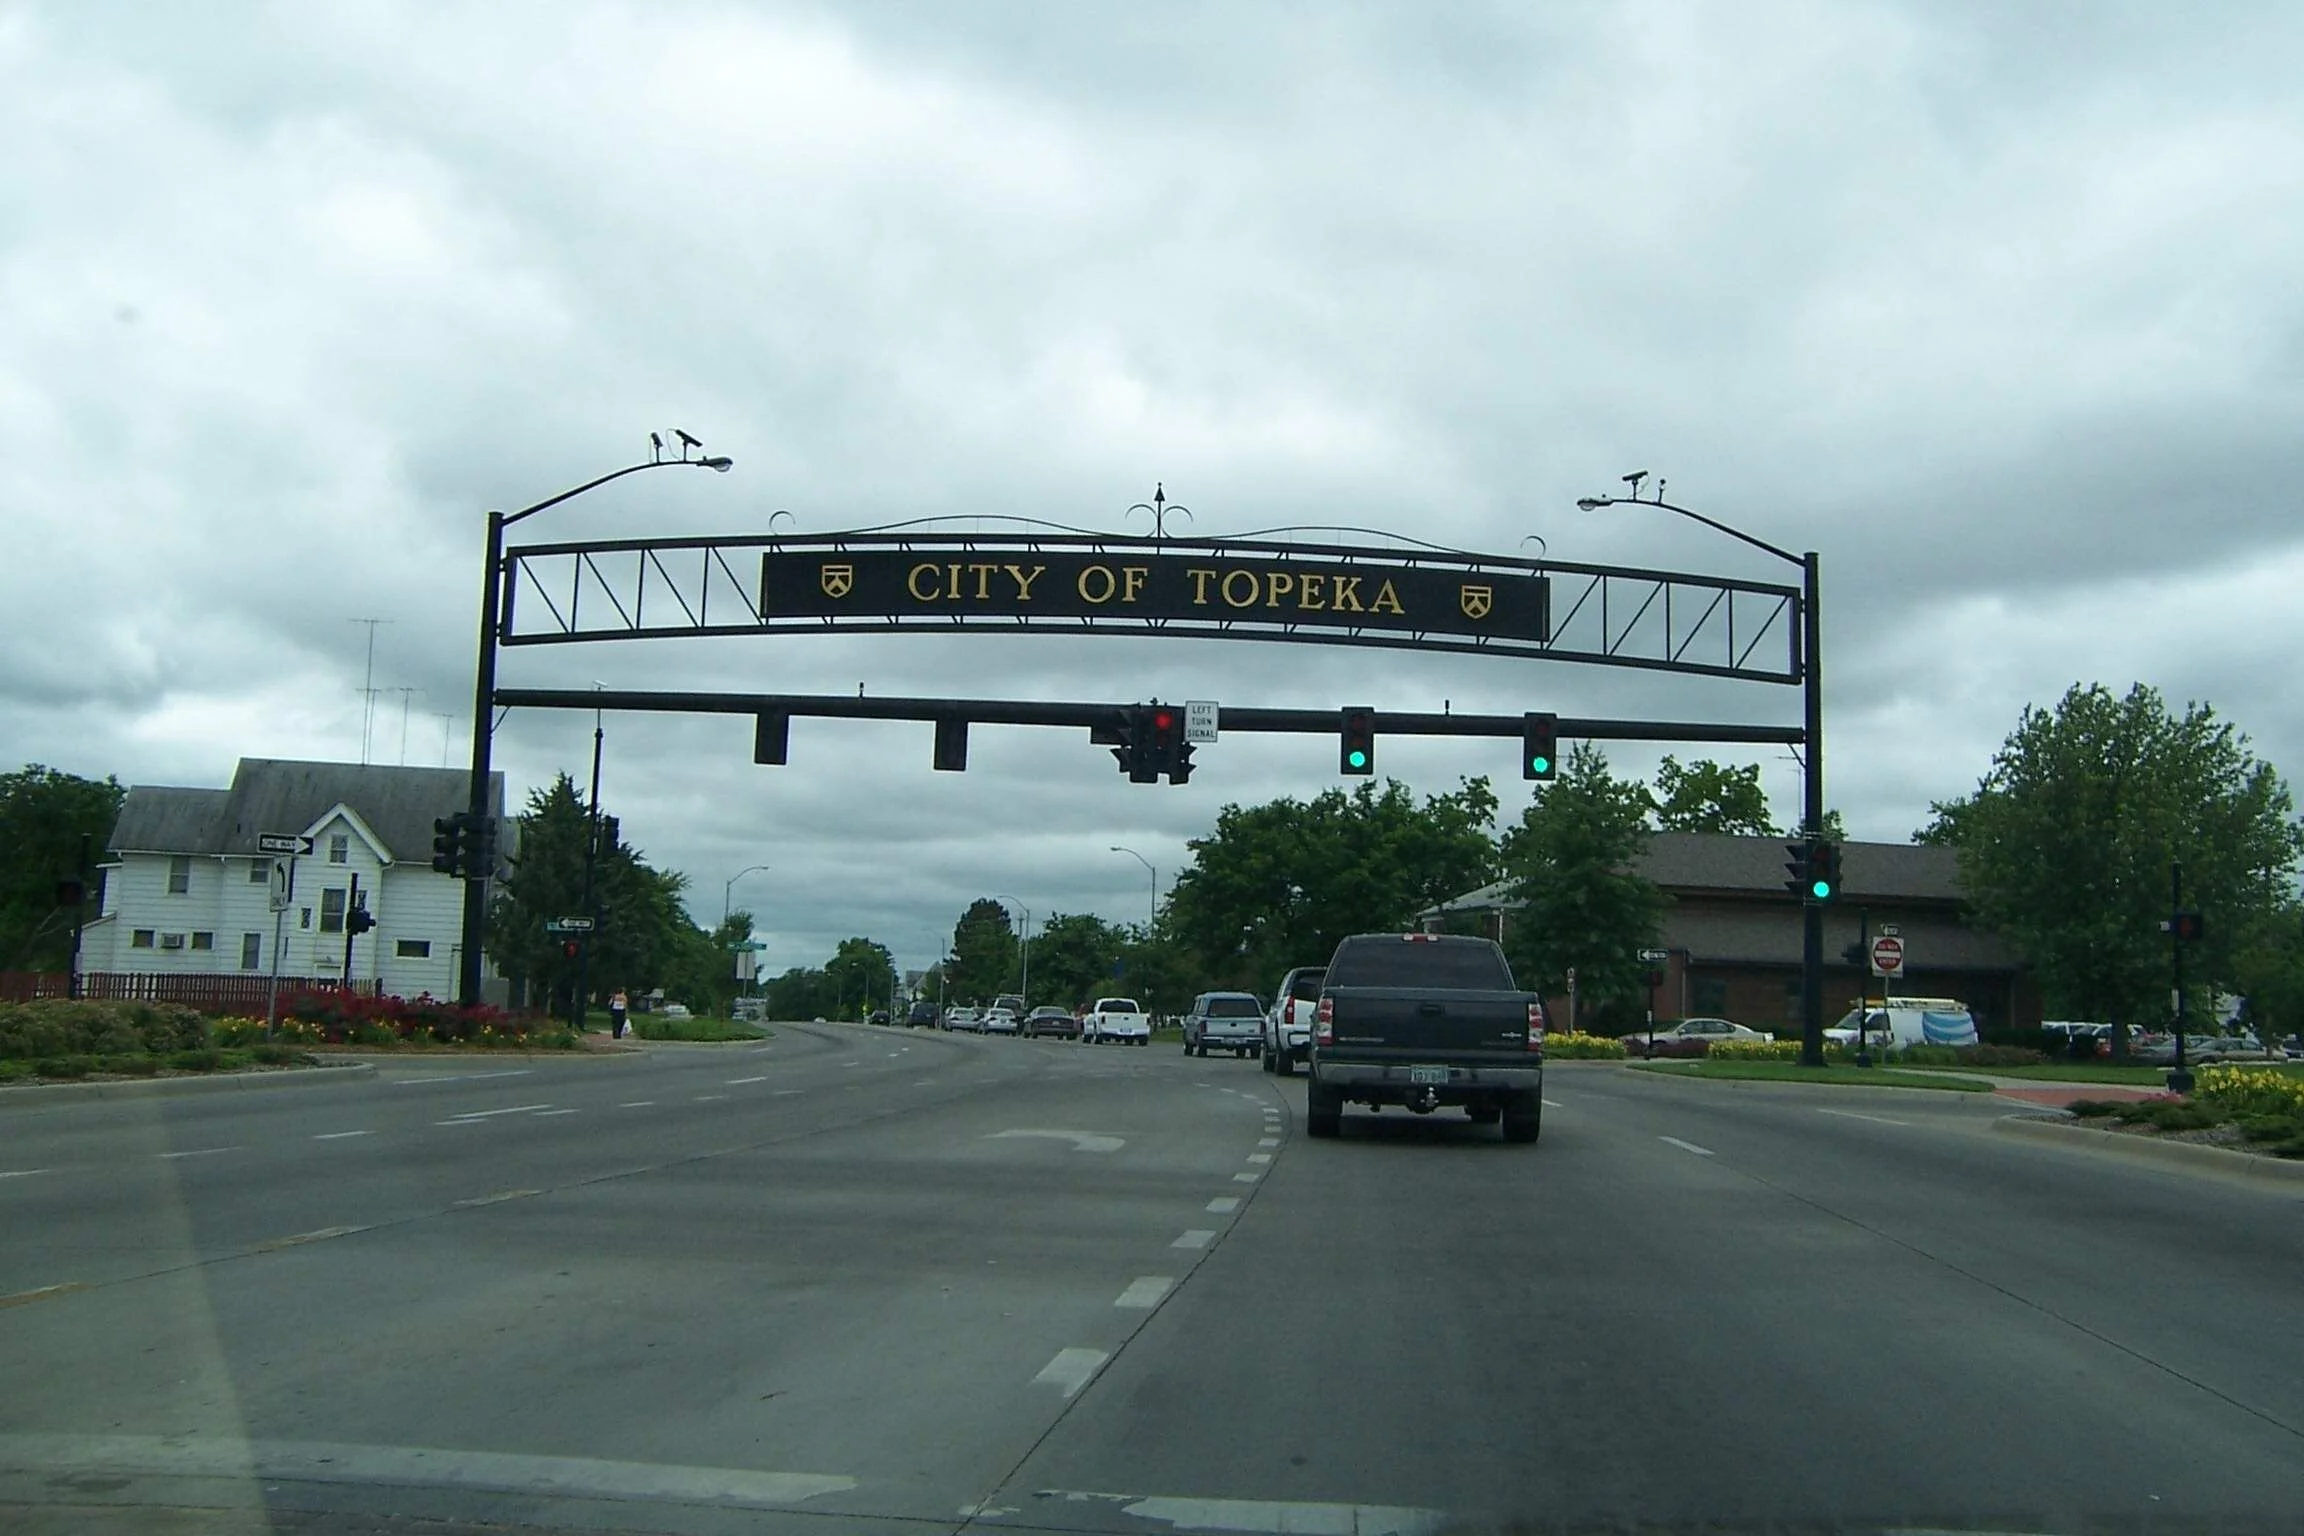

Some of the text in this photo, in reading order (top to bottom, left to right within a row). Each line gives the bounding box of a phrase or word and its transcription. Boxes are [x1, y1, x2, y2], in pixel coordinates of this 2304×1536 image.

[907, 564, 1405, 615] CITY OF TOPEKA
[1192, 705, 1212, 714] LEFT
[1192, 717, 1212, 725] TURN
[1187, 729, 1216, 738] SIGNAL
